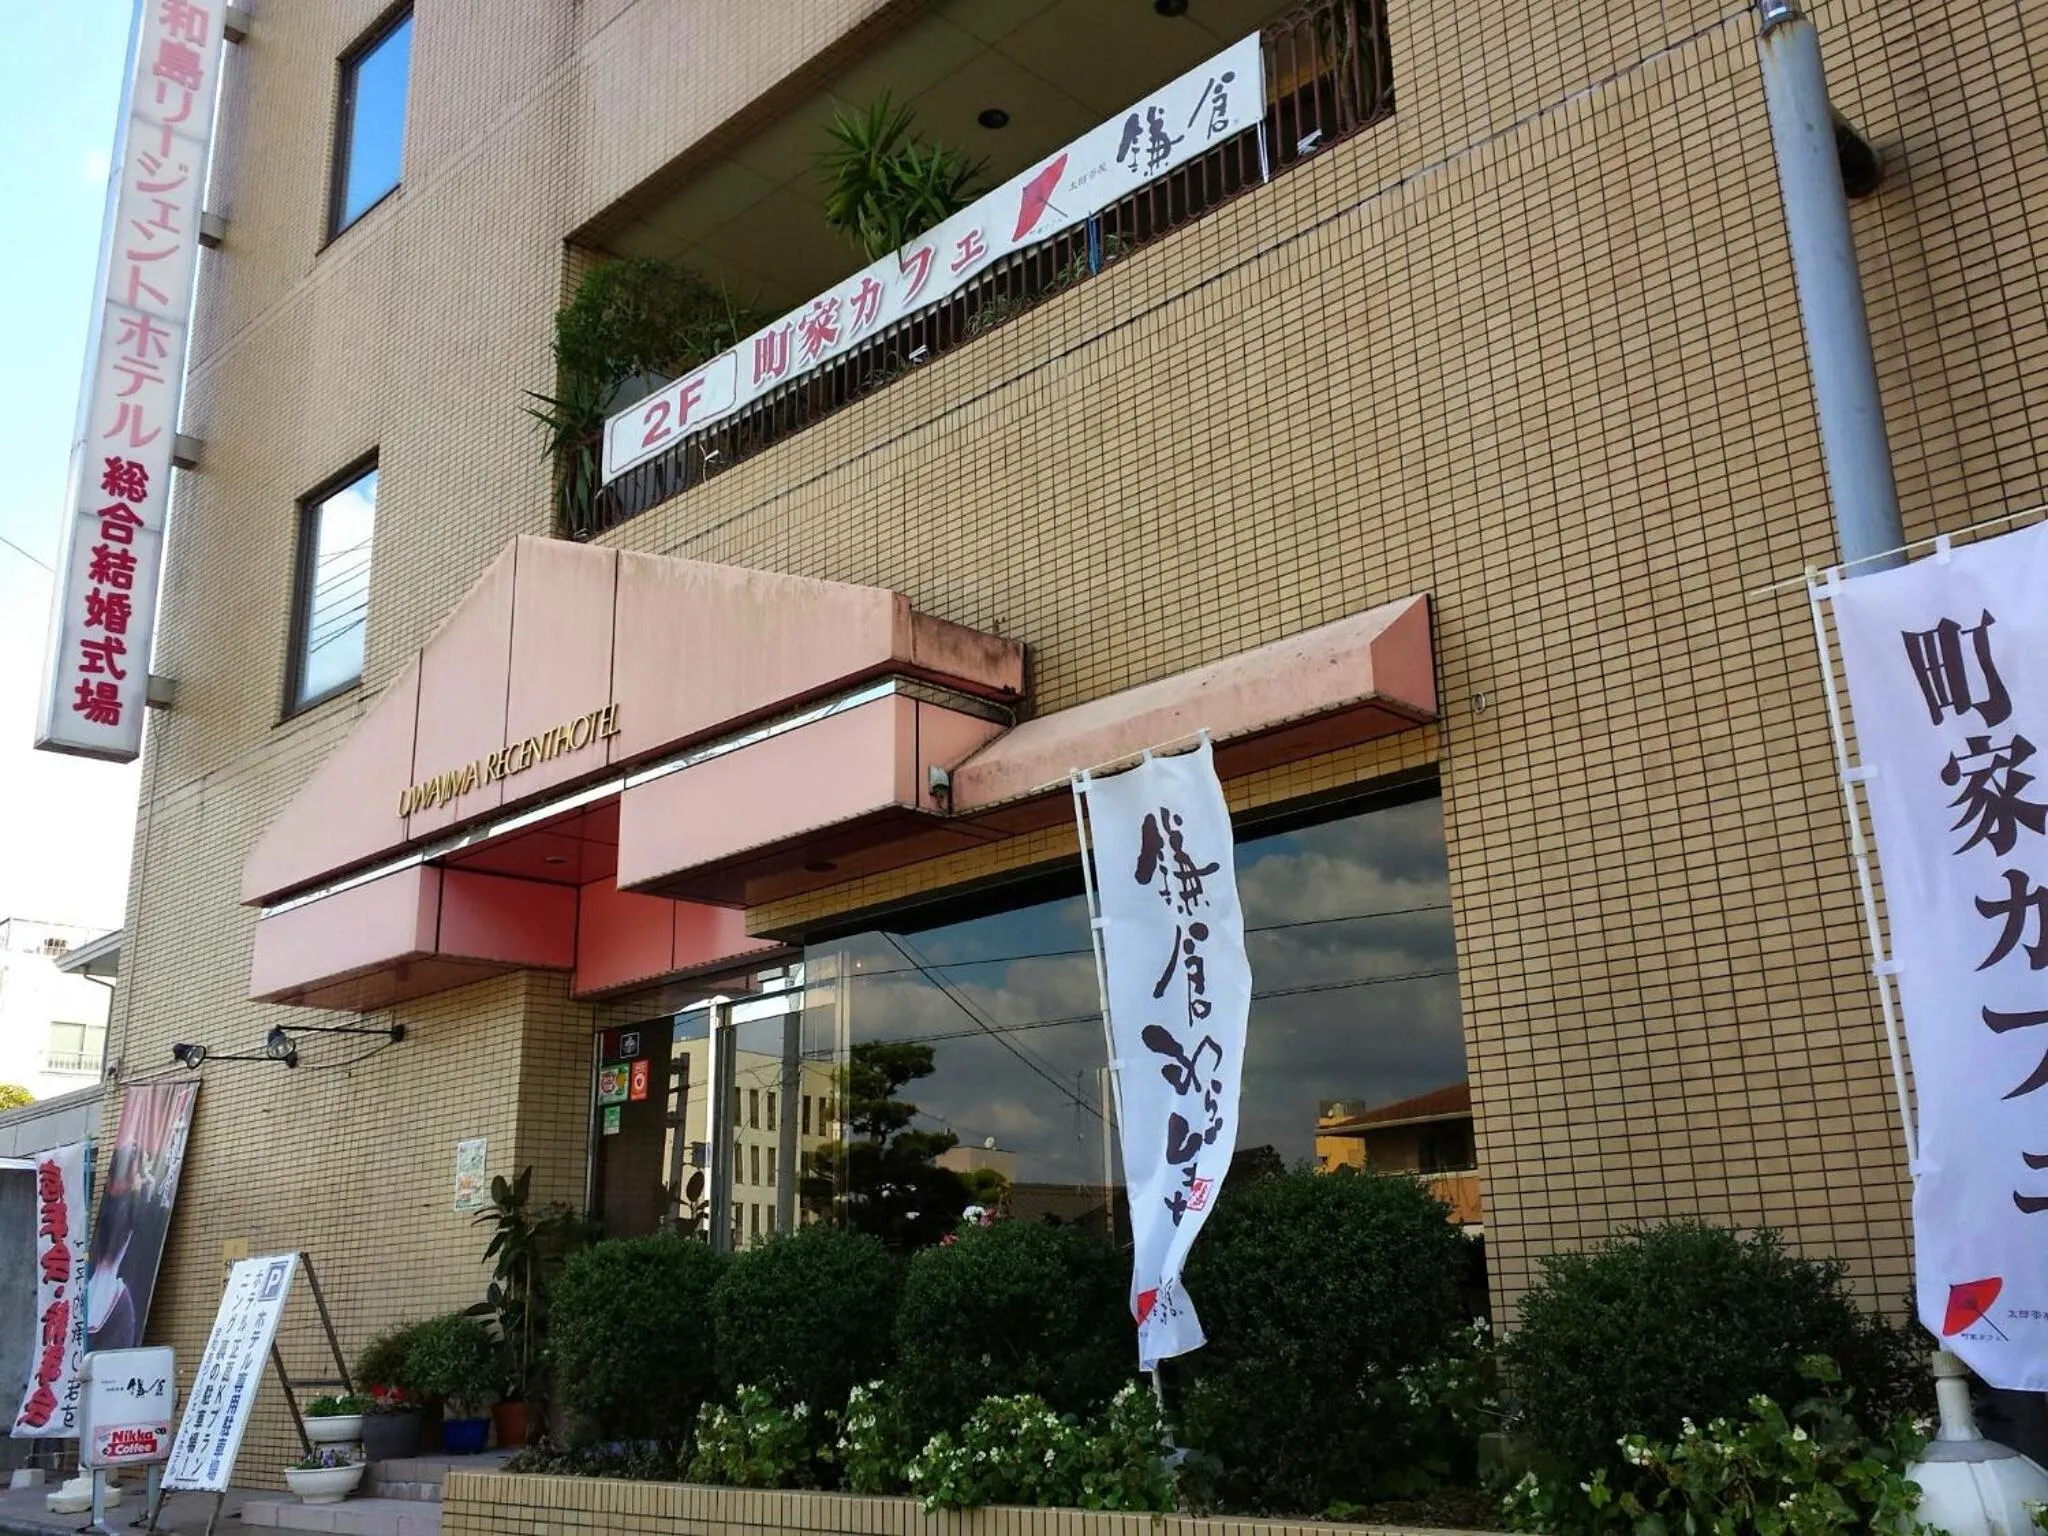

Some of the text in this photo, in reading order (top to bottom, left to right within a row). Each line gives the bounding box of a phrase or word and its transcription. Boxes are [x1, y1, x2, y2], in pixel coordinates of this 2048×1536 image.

[641, 228, 985, 449] 2F 町家カフェ
[72, 456, 150, 727] 総合結婚式場
[111, 1428, 154, 1443] Nikka
[114, 1443, 154, 1456] Coffee
